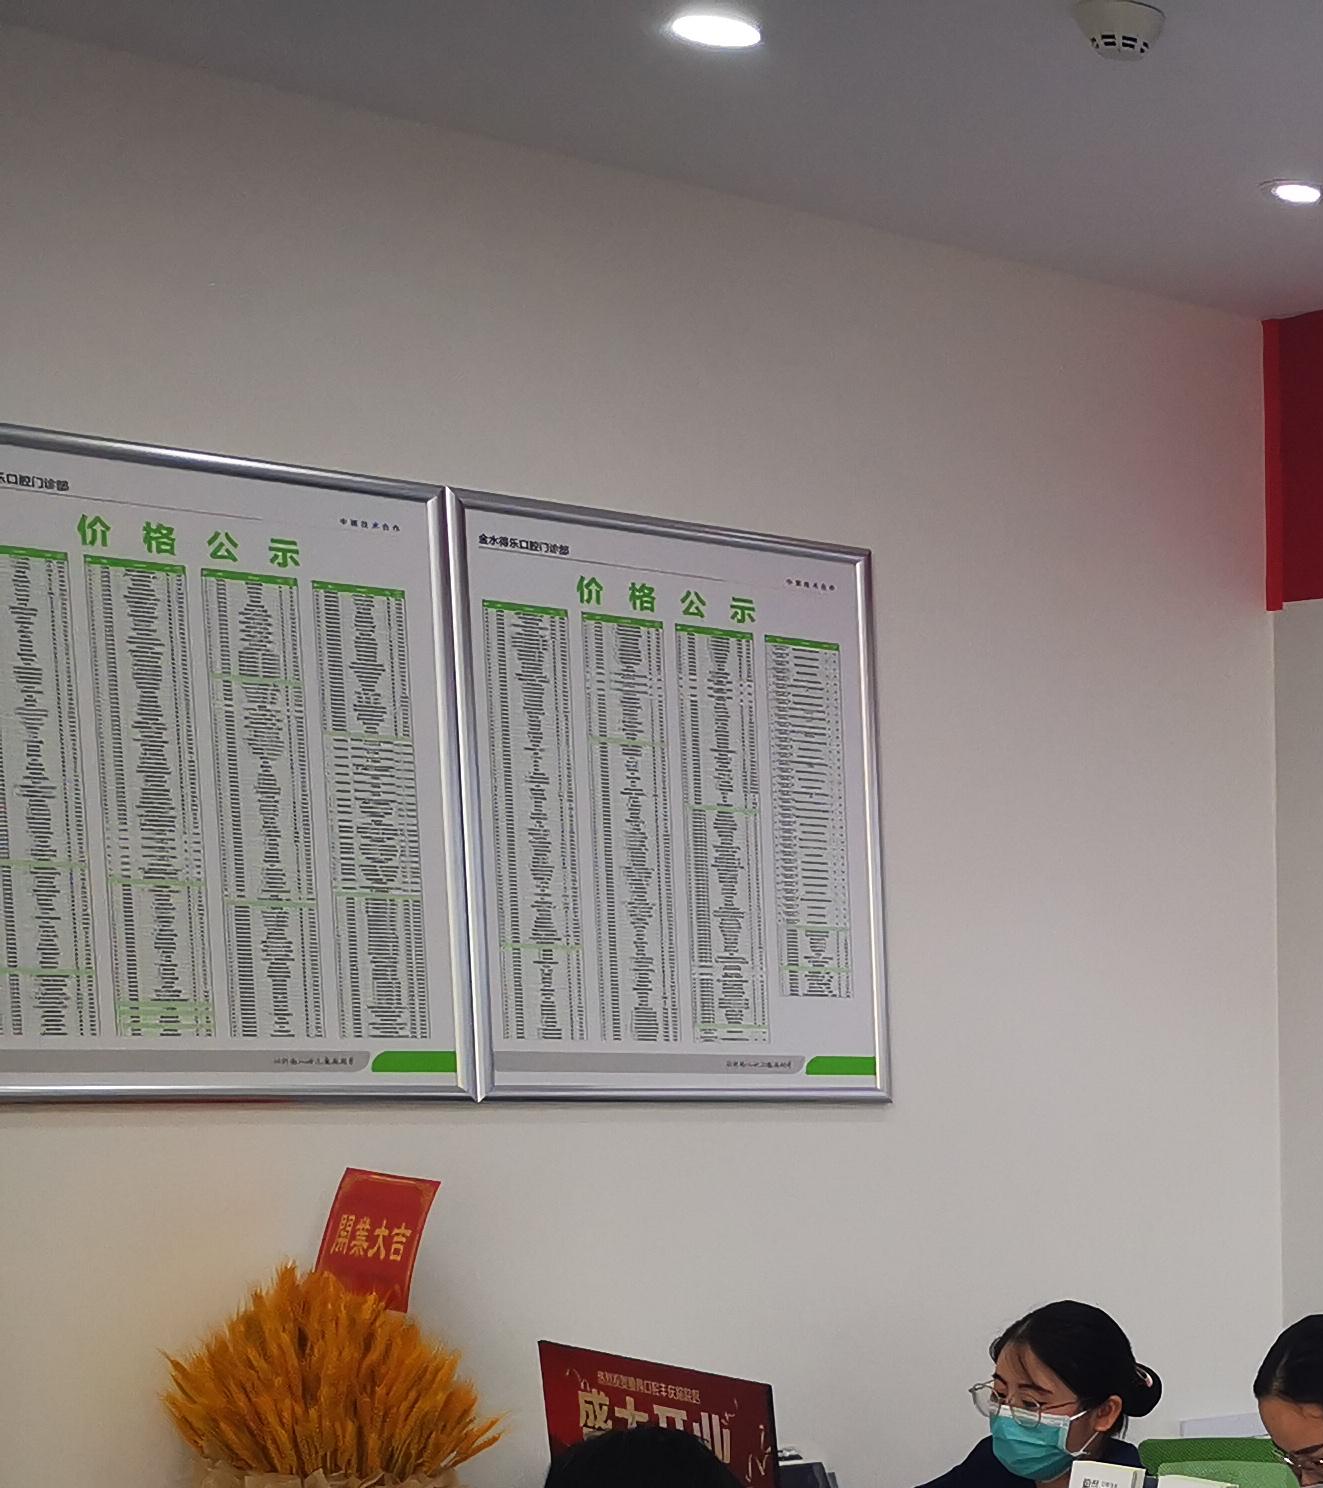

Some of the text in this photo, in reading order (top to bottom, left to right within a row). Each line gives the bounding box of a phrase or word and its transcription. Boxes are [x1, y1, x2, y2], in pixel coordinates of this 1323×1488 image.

[76, 513, 301, 568] 价格公示
[575, 575, 757, 625] 价格公示
